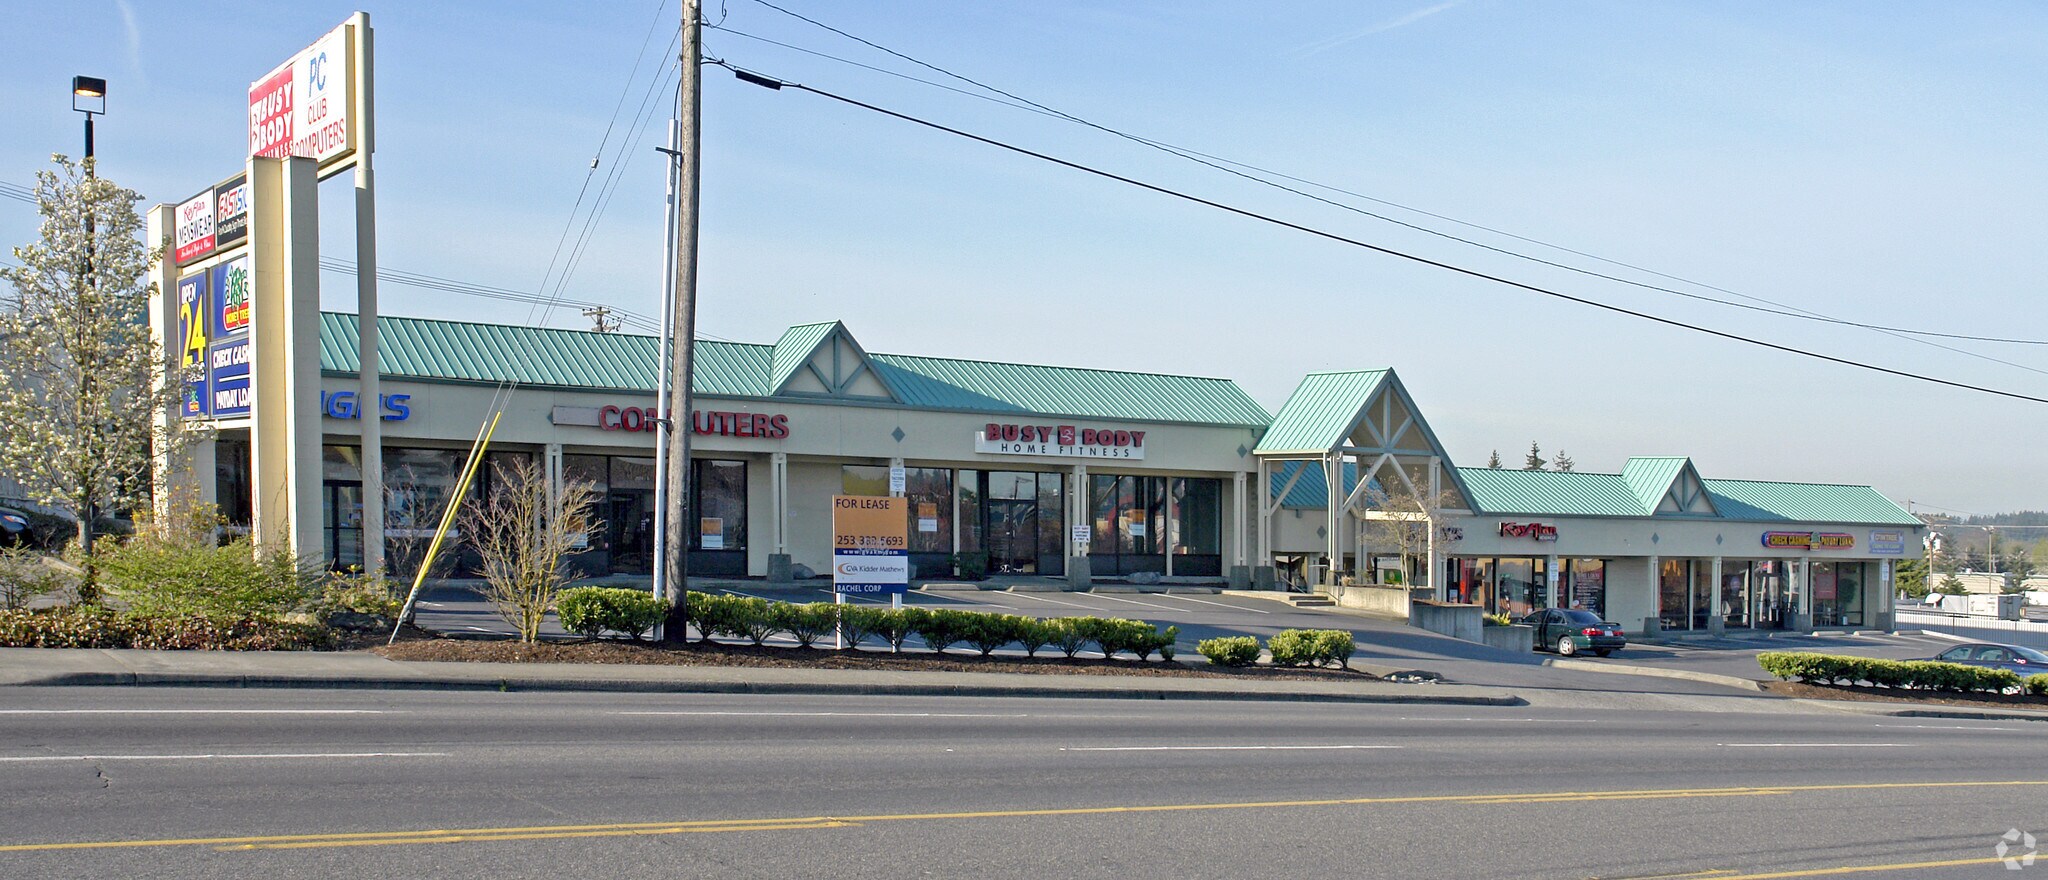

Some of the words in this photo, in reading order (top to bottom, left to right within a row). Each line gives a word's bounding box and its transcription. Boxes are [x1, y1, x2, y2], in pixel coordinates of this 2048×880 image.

[309, 51, 327, 98] PC
[260, 81, 293, 122] BUSY
[307, 98, 327, 125] CLUB
[260, 110, 293, 149] BODY
[294, 118, 345, 158] COMPUTERS
[261, 140, 294, 158] ITNESS
[180, 293, 206, 369] 24
[213, 347, 233, 370] CHECK
[216, 389, 238, 410] PAYDAY
[600, 404, 790, 439] COMUTERS
[986, 423, 1053, 443] BUSY
[1082, 428, 1146, 448] BODY
[1001, 443, 1047, 454] HOME
[1059, 446, 1130, 458] FITNESS
[836, 498, 858, 509] FOR
[860, 499, 890, 510] LEASE
[837, 535, 856, 546] 253
[846, 565, 858, 573] GVA
[879, 566, 905, 574] Mathews
[836, 584, 862, 593] RACHEL
[863, 585, 882, 593] CORP
